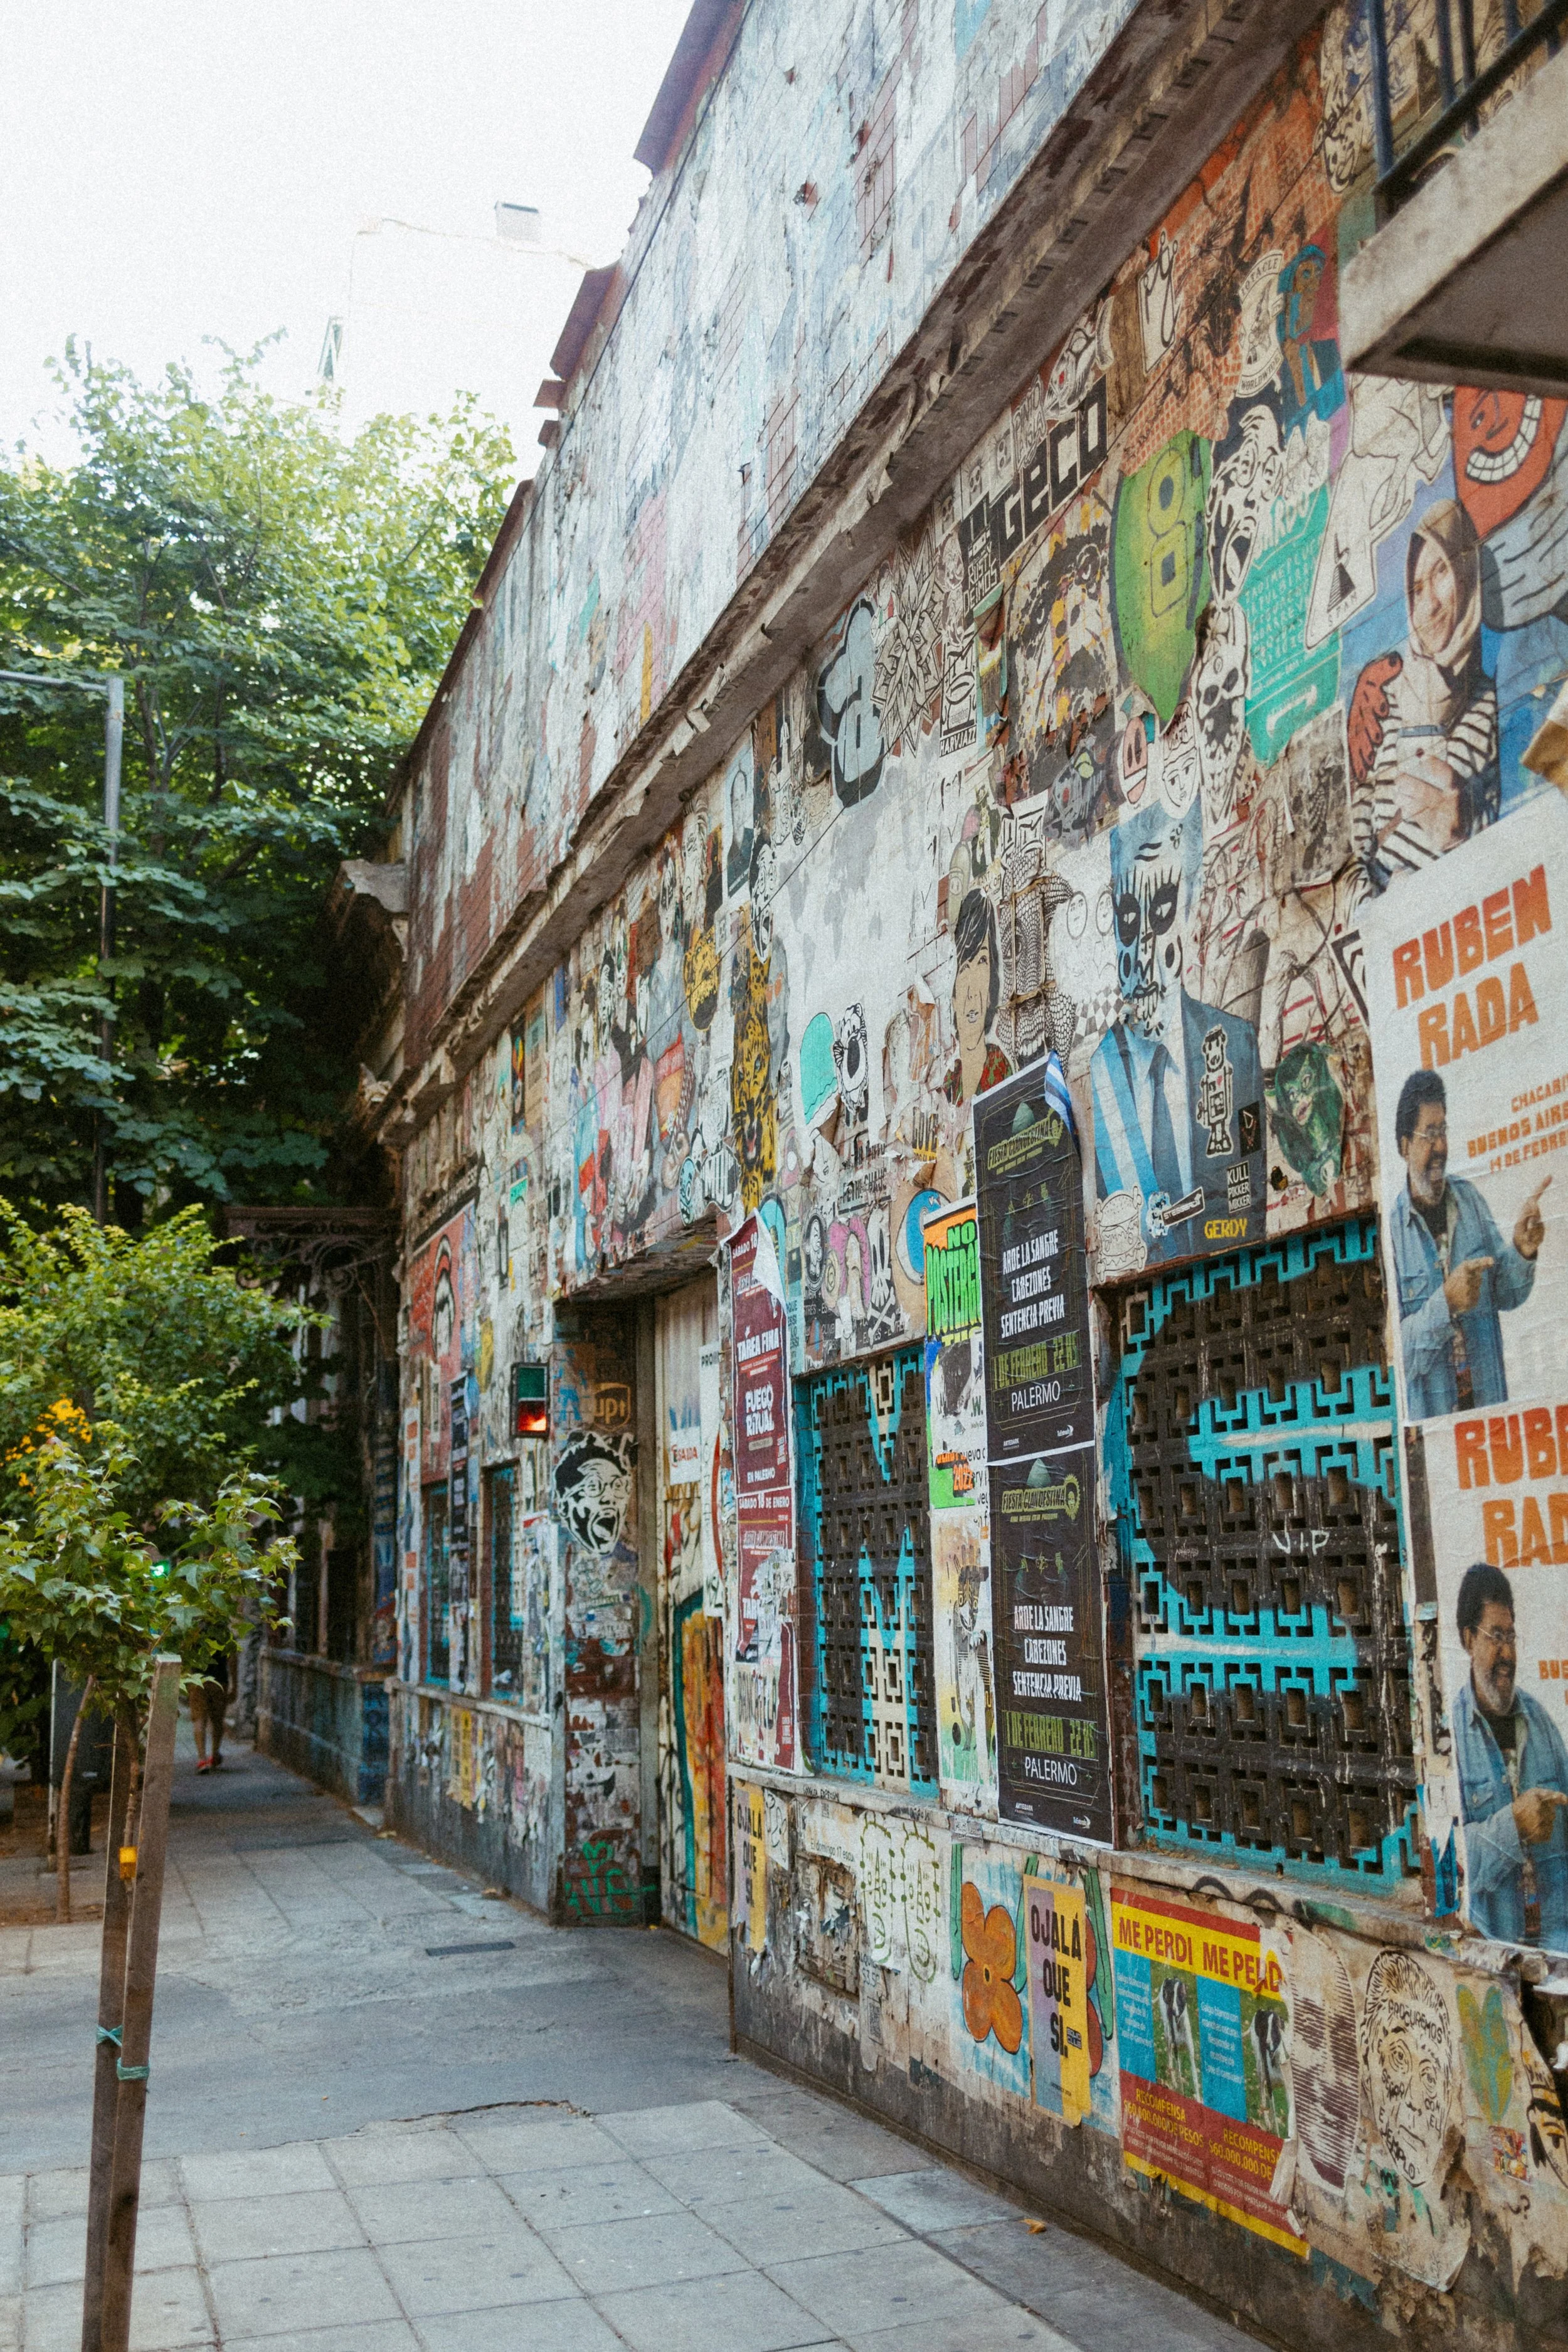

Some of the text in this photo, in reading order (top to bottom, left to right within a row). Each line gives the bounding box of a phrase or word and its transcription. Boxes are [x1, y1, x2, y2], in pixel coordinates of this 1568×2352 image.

[1392, 864, 1552, 1010] RUBEN
[1417, 961, 1539, 1070] RADA
[1468, 1117, 1532, 1159] BUENOS
[1505, 1149, 1520, 1167] DE
[1523, 1130, 1568, 1161] FEBRE
[1227, 1165, 1249, 1185] KULL
[1228, 1182, 1250, 1200] PIKKER
[1229, 1195, 1251, 1211] MIKKER
[947, 1221, 976, 1251] NO
[1204, 1217, 1248, 1239] GERDY
[1003, 1229, 1059, 1275] ARDE LA SANGRE
[1011, 1265, 1051, 1303] CABEZONES
[1001, 1293, 1065, 1338] SENTENCIA PREVIA
[737, 1327, 780, 1362] TAREA FINA
[745, 1381, 774, 1414] FUEGO
[1011, 1380, 1061, 1412] PALERMO
[746, 1411, 775, 1437] RITUAL
[1014, 1605, 1074, 1632] ARDE LA SANGRE
[1024, 1638, 1067, 1666] CABEZONES
[1013, 1671, 1082, 1702] SENTENCIA PREVIA
[1024, 1712, 1064, 1753] FEBRERO
[1069, 1719, 1082, 1756] 22
[1024, 1756, 1078, 1786] PALERMO
[1030, 1904, 1082, 1961] OJALÁ
[1119, 1916, 1193, 1966] ME PERDI
[1202, 1941, 1229, 1978] ME
[1042, 1957, 1071, 2007] QUE
[1387, 1999, 1443, 2044] PROCUREMOS
[1136, 2088, 1187, 2123] RECOMPENSA
[1424, 2097, 1441, 2113] CON
[1179, 2125, 1204, 2148] PESOS
[1429, 2114, 1442, 2136] EL
[1209, 2139, 1259, 2175] $60.000.000
[1261, 2163, 1273, 2181] DE
